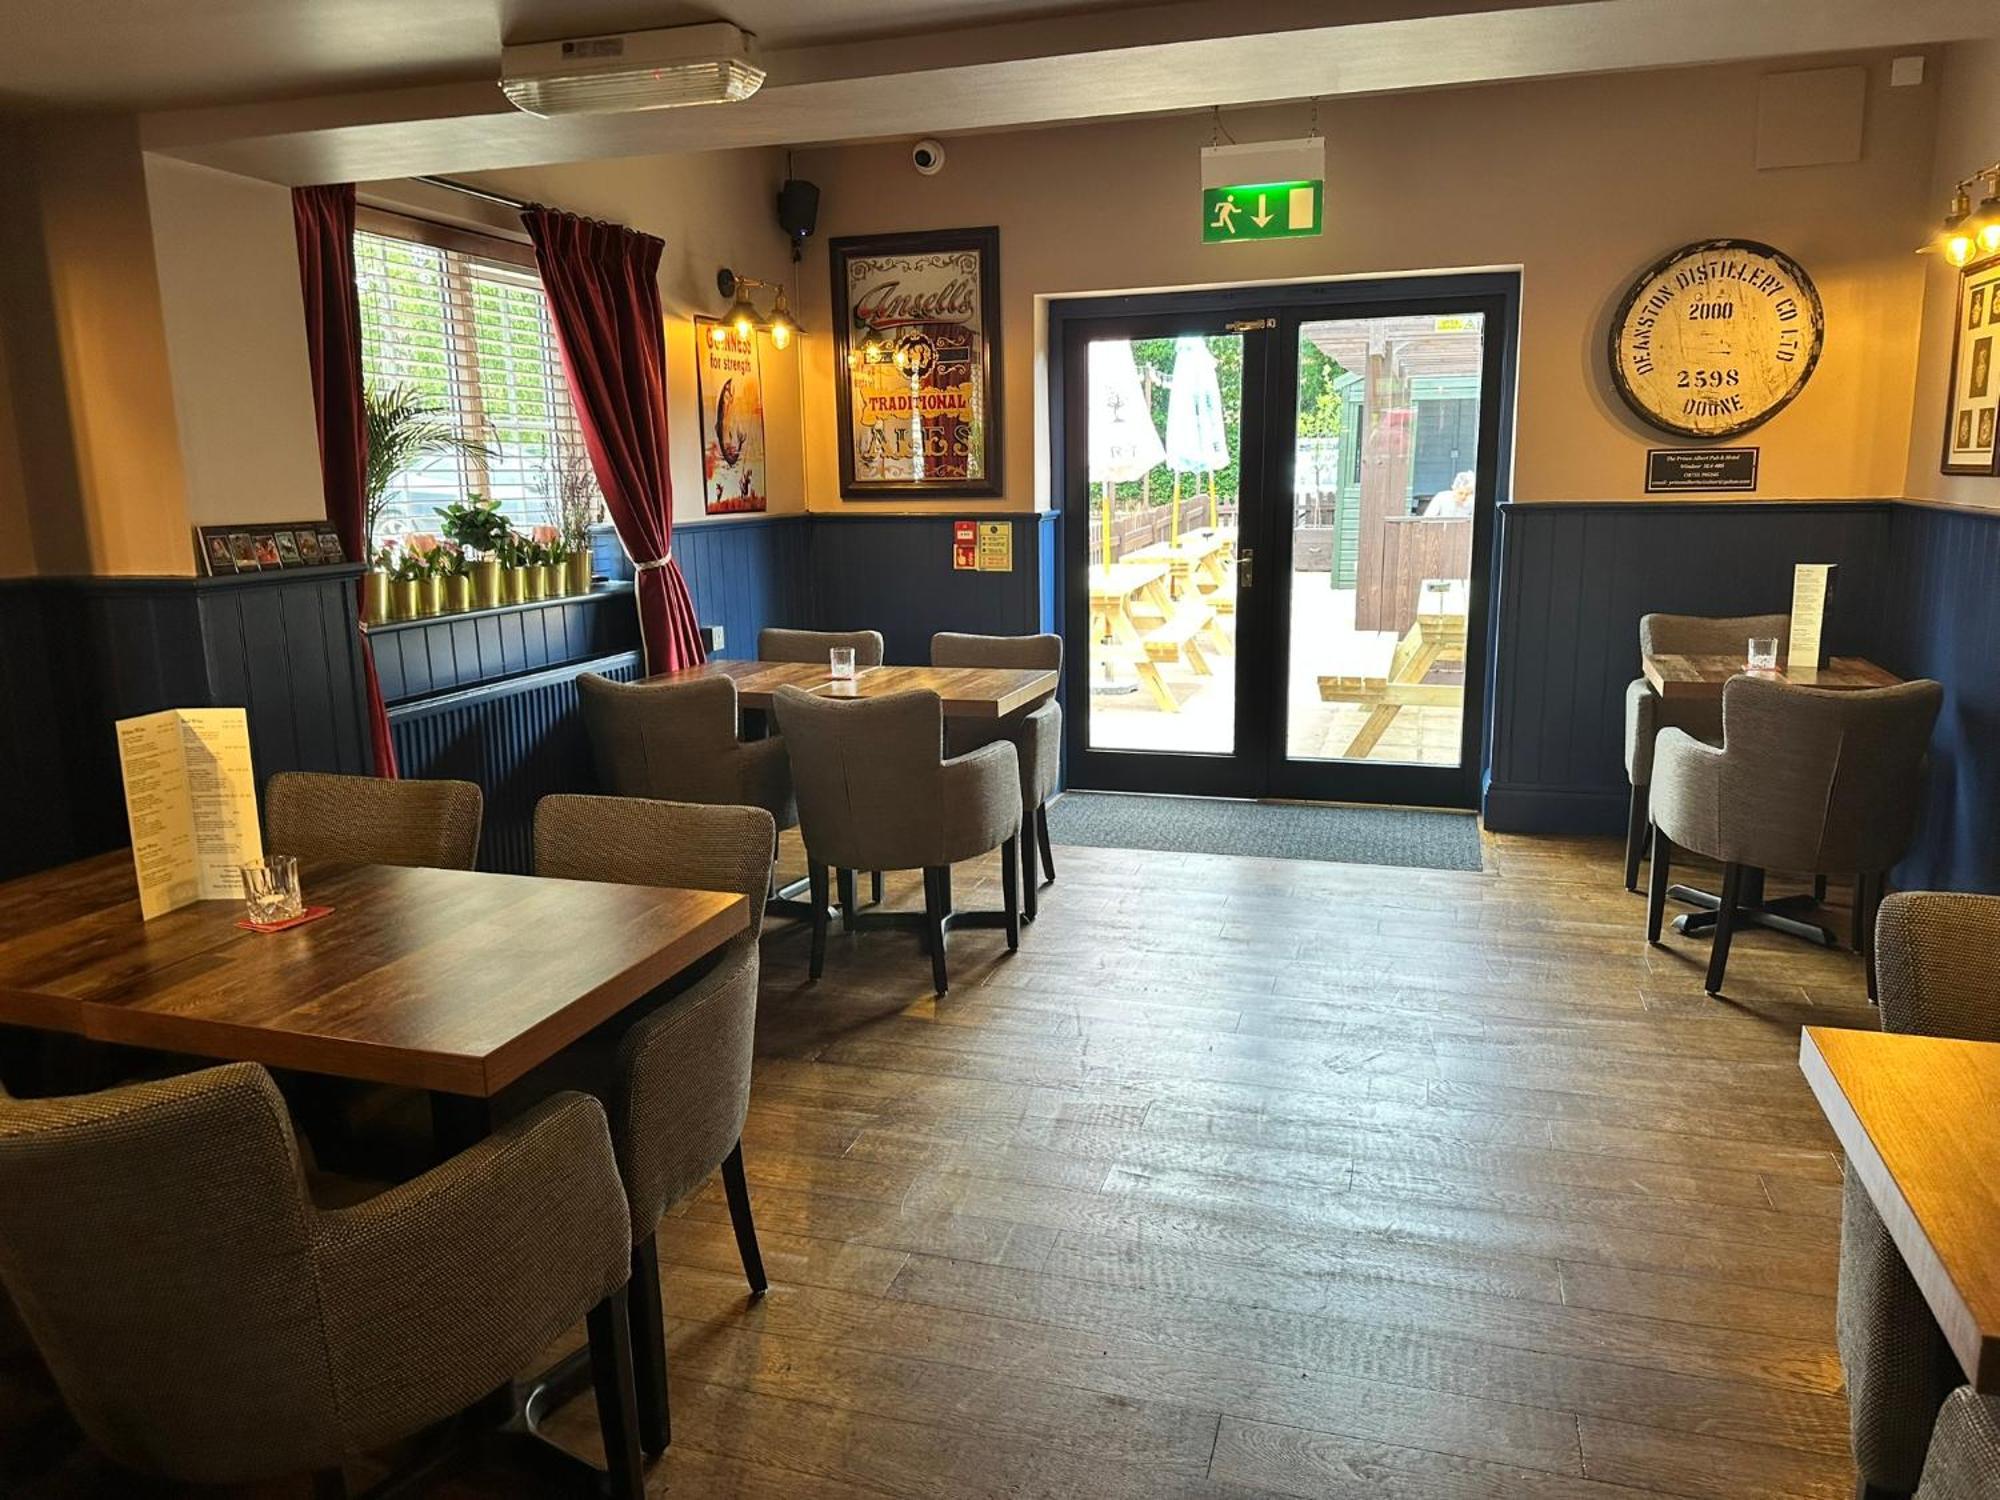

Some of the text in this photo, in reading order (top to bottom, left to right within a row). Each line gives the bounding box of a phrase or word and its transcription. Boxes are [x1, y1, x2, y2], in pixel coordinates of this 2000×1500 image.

[1633, 260, 1799, 376] DEANSTON DISTILLERY CO LTD
[1688, 301, 1734, 321] 2000
[710, 353, 721, 371] for
[1676, 368, 1740, 389] 2598
[868, 394, 967, 413] TRADITIONAL
